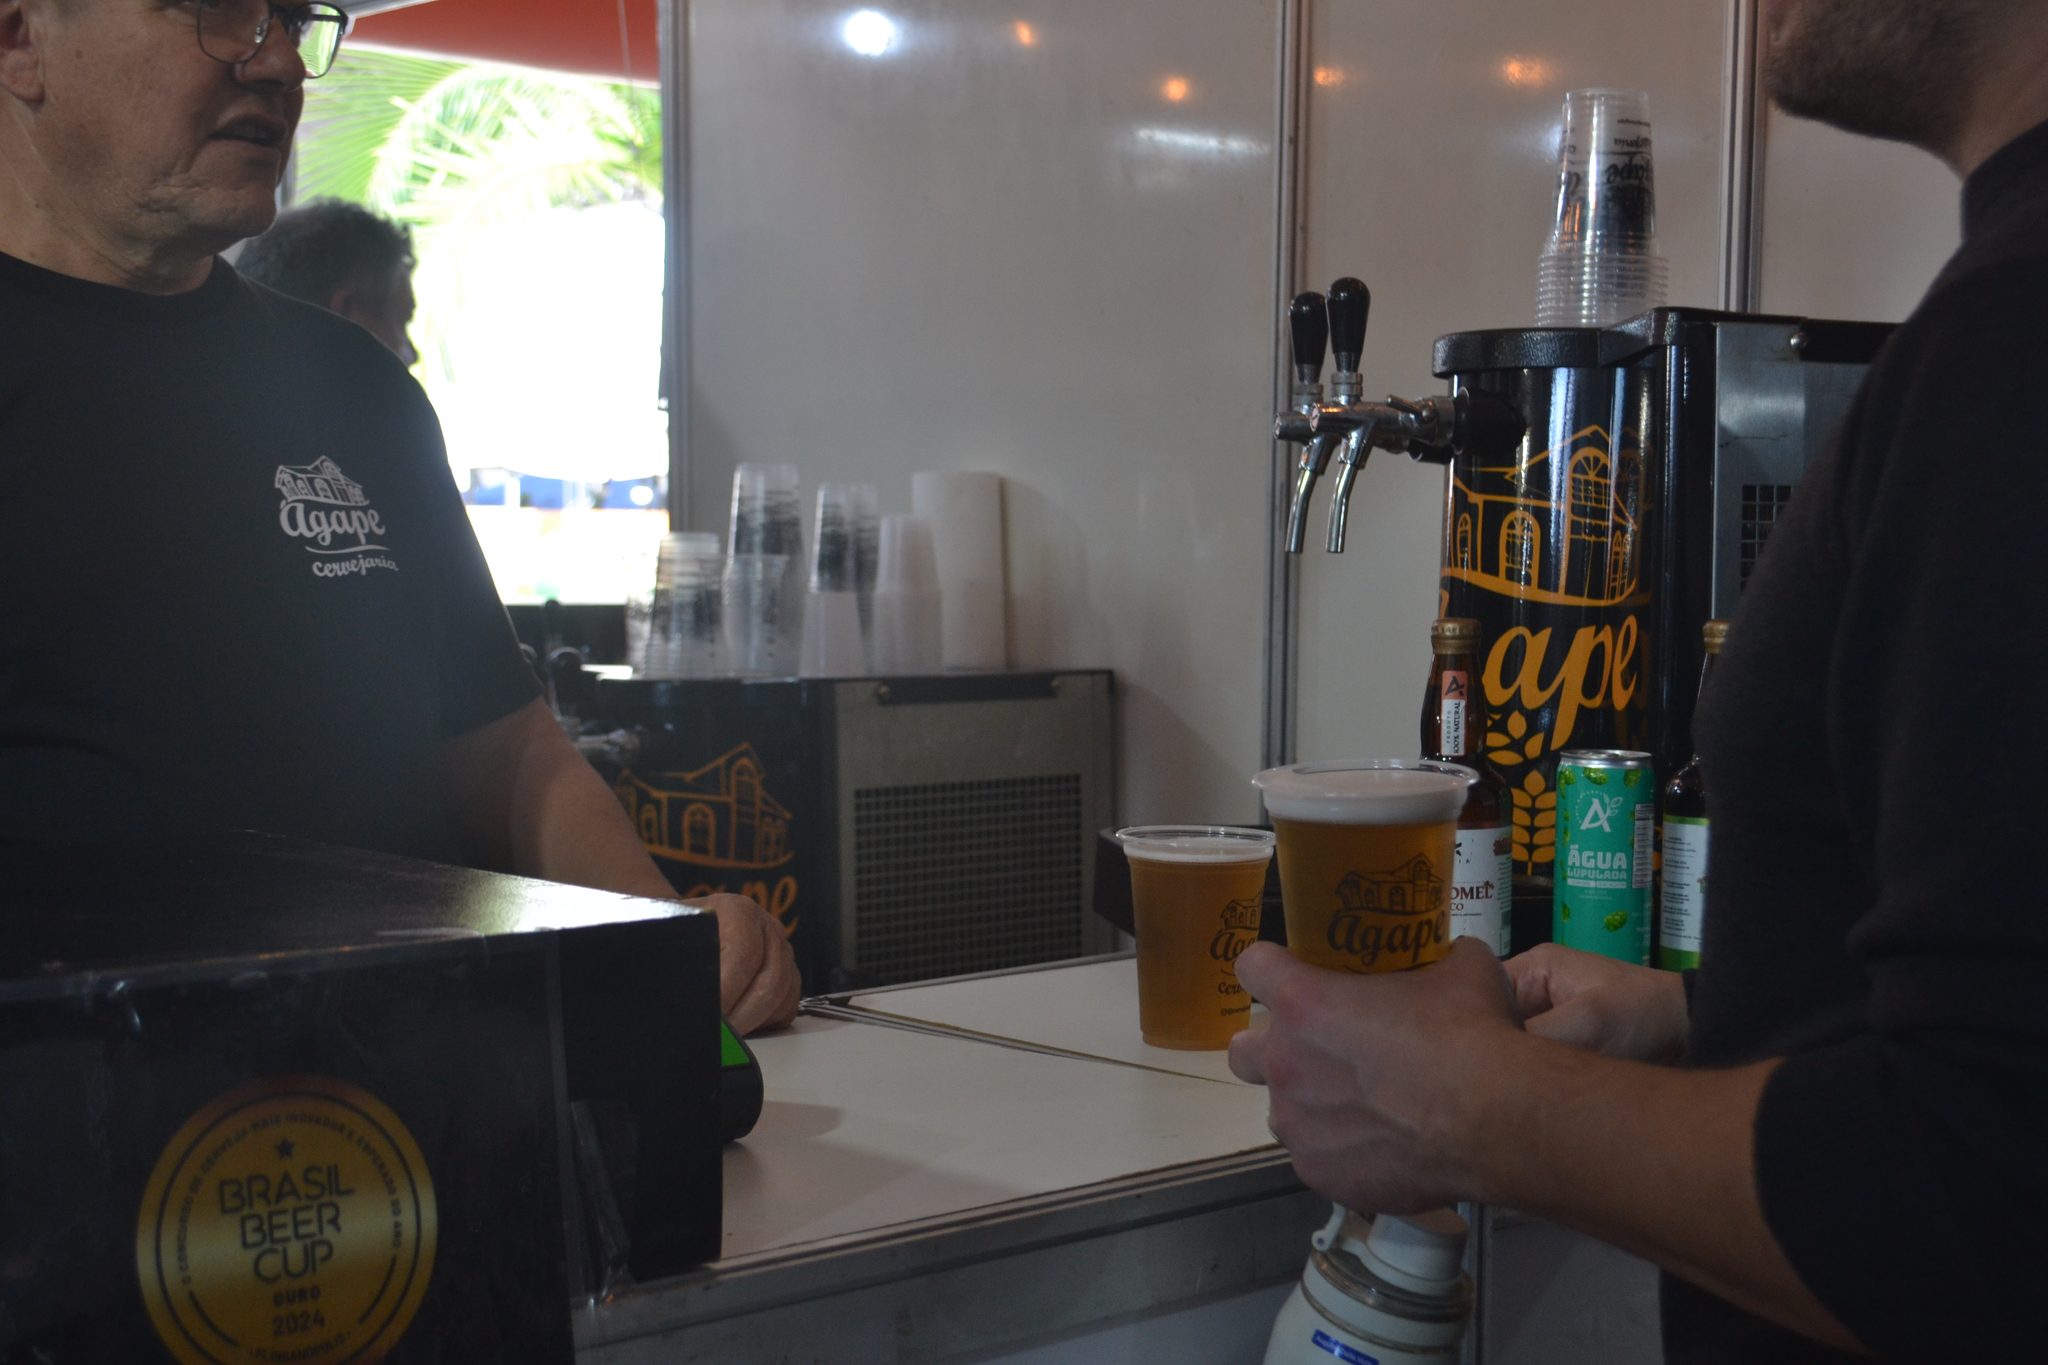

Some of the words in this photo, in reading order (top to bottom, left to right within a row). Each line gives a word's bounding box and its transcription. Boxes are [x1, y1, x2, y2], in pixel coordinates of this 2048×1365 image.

[1453, 702, 1461, 733] NATURAL
[1567, 844, 1627, 869] ÁGUA
[1567, 867, 1627, 880] LUPULADA
[219, 1164, 354, 1215] BRASIL
[240, 1202, 342, 1250] BEER
[253, 1240, 334, 1283] CUP
[273, 1286, 321, 1307] OURO
[272, 1311, 325, 1337] 2024
